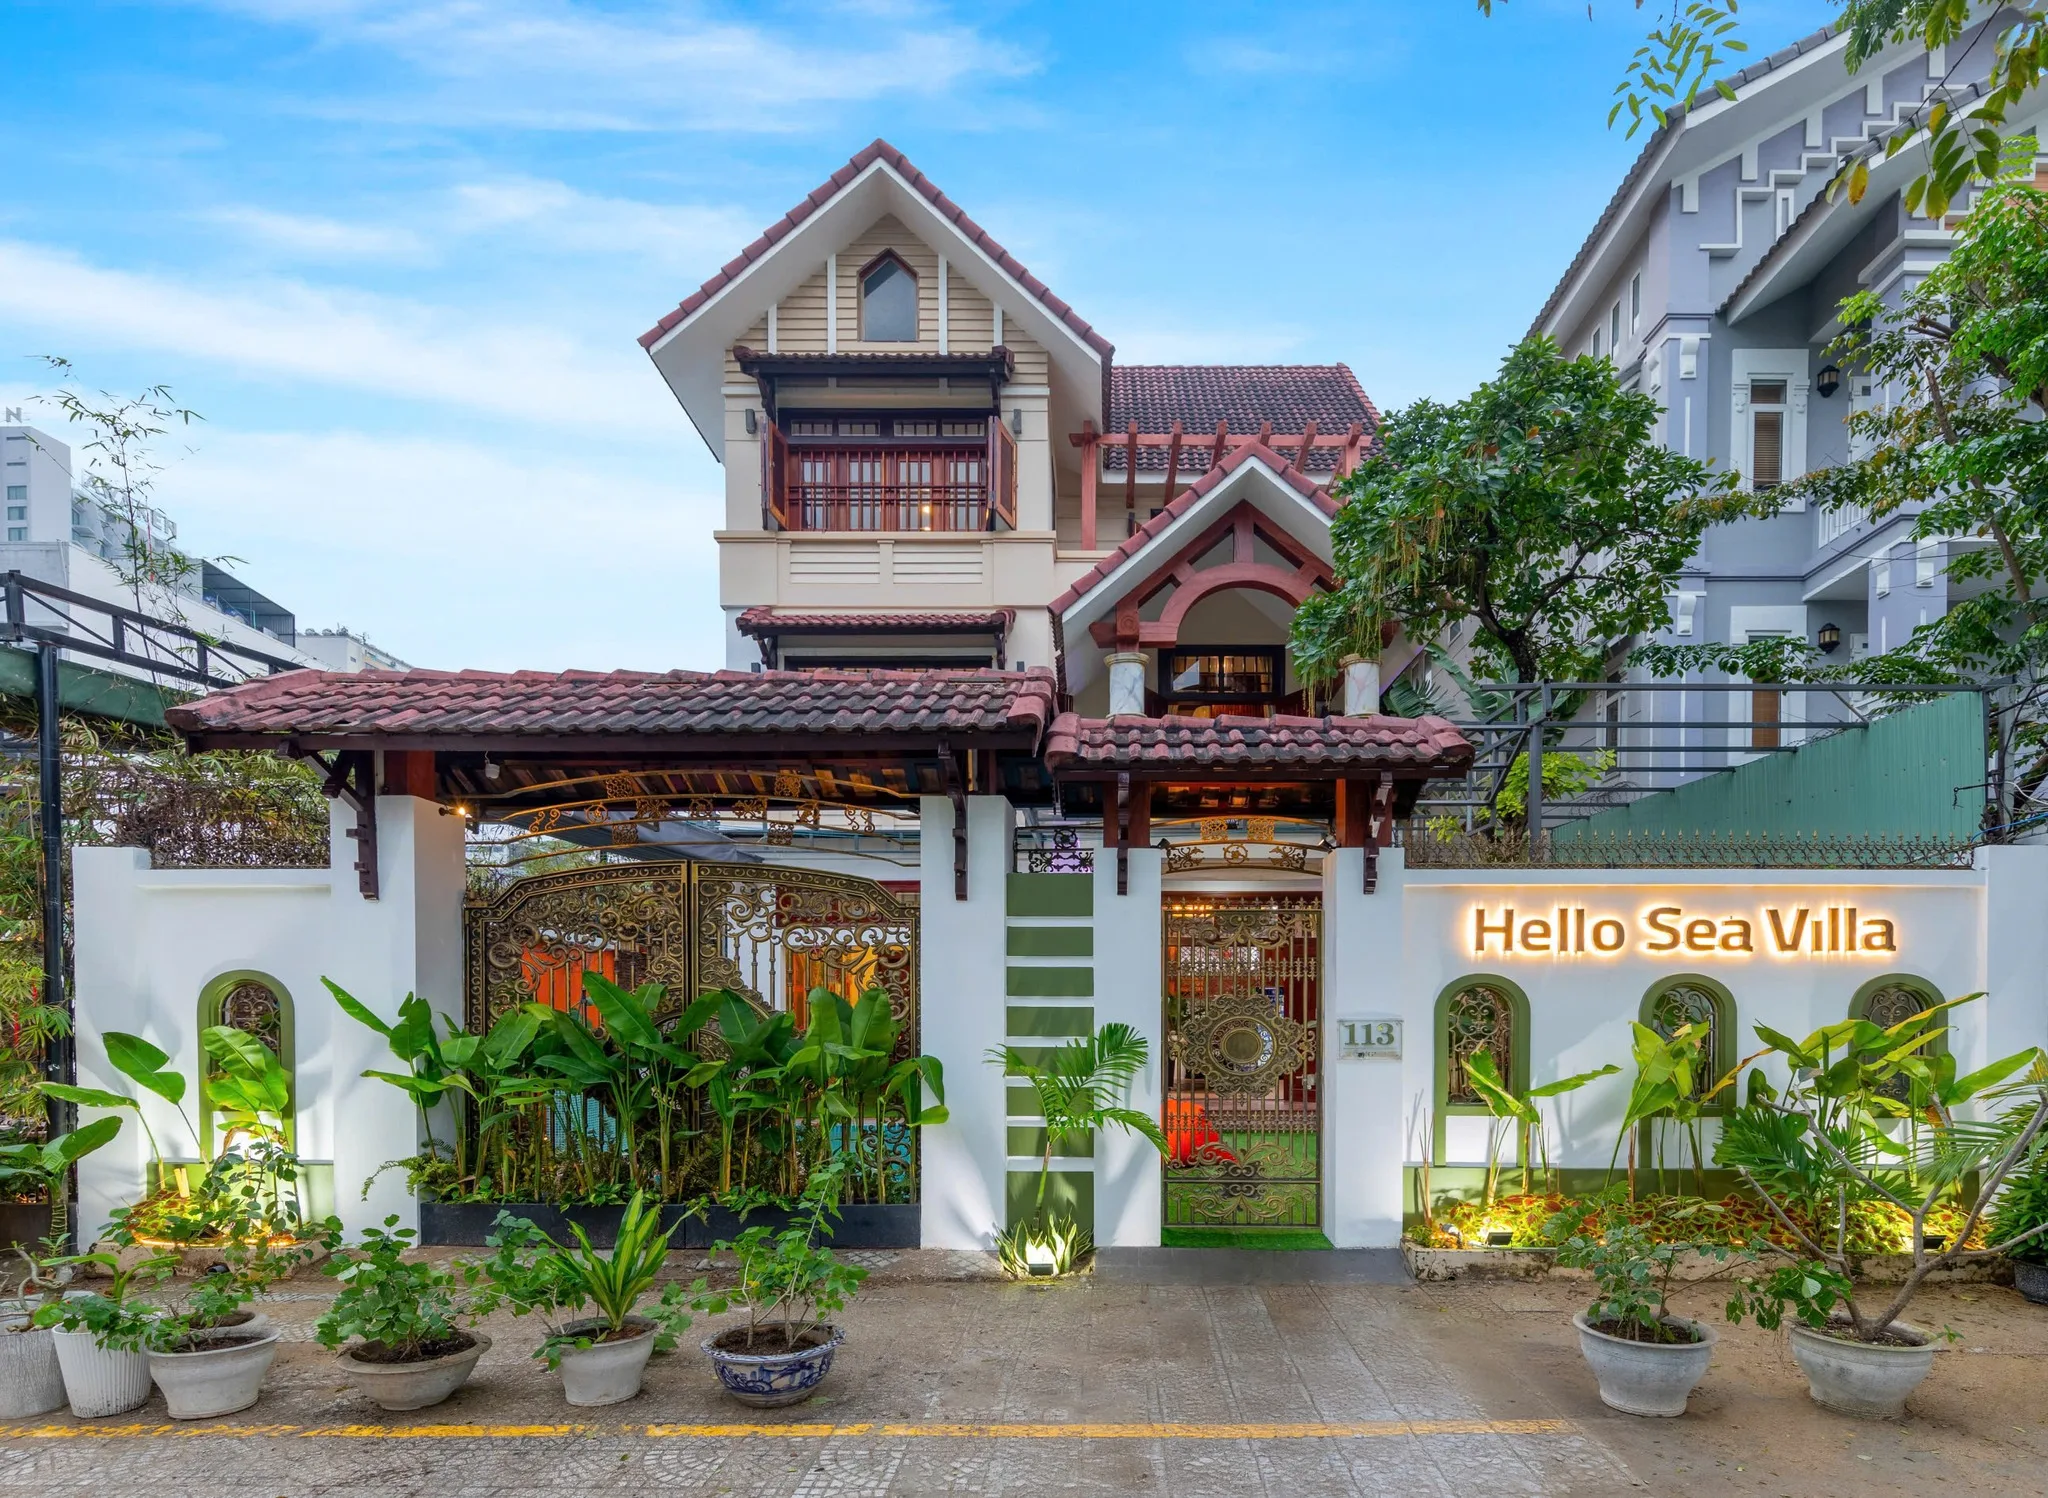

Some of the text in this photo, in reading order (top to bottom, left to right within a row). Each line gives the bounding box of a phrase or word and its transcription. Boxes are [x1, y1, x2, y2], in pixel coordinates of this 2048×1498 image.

[1475, 907, 1897, 952] Hello Sea Villa
[1344, 1023, 1395, 1046] 113
